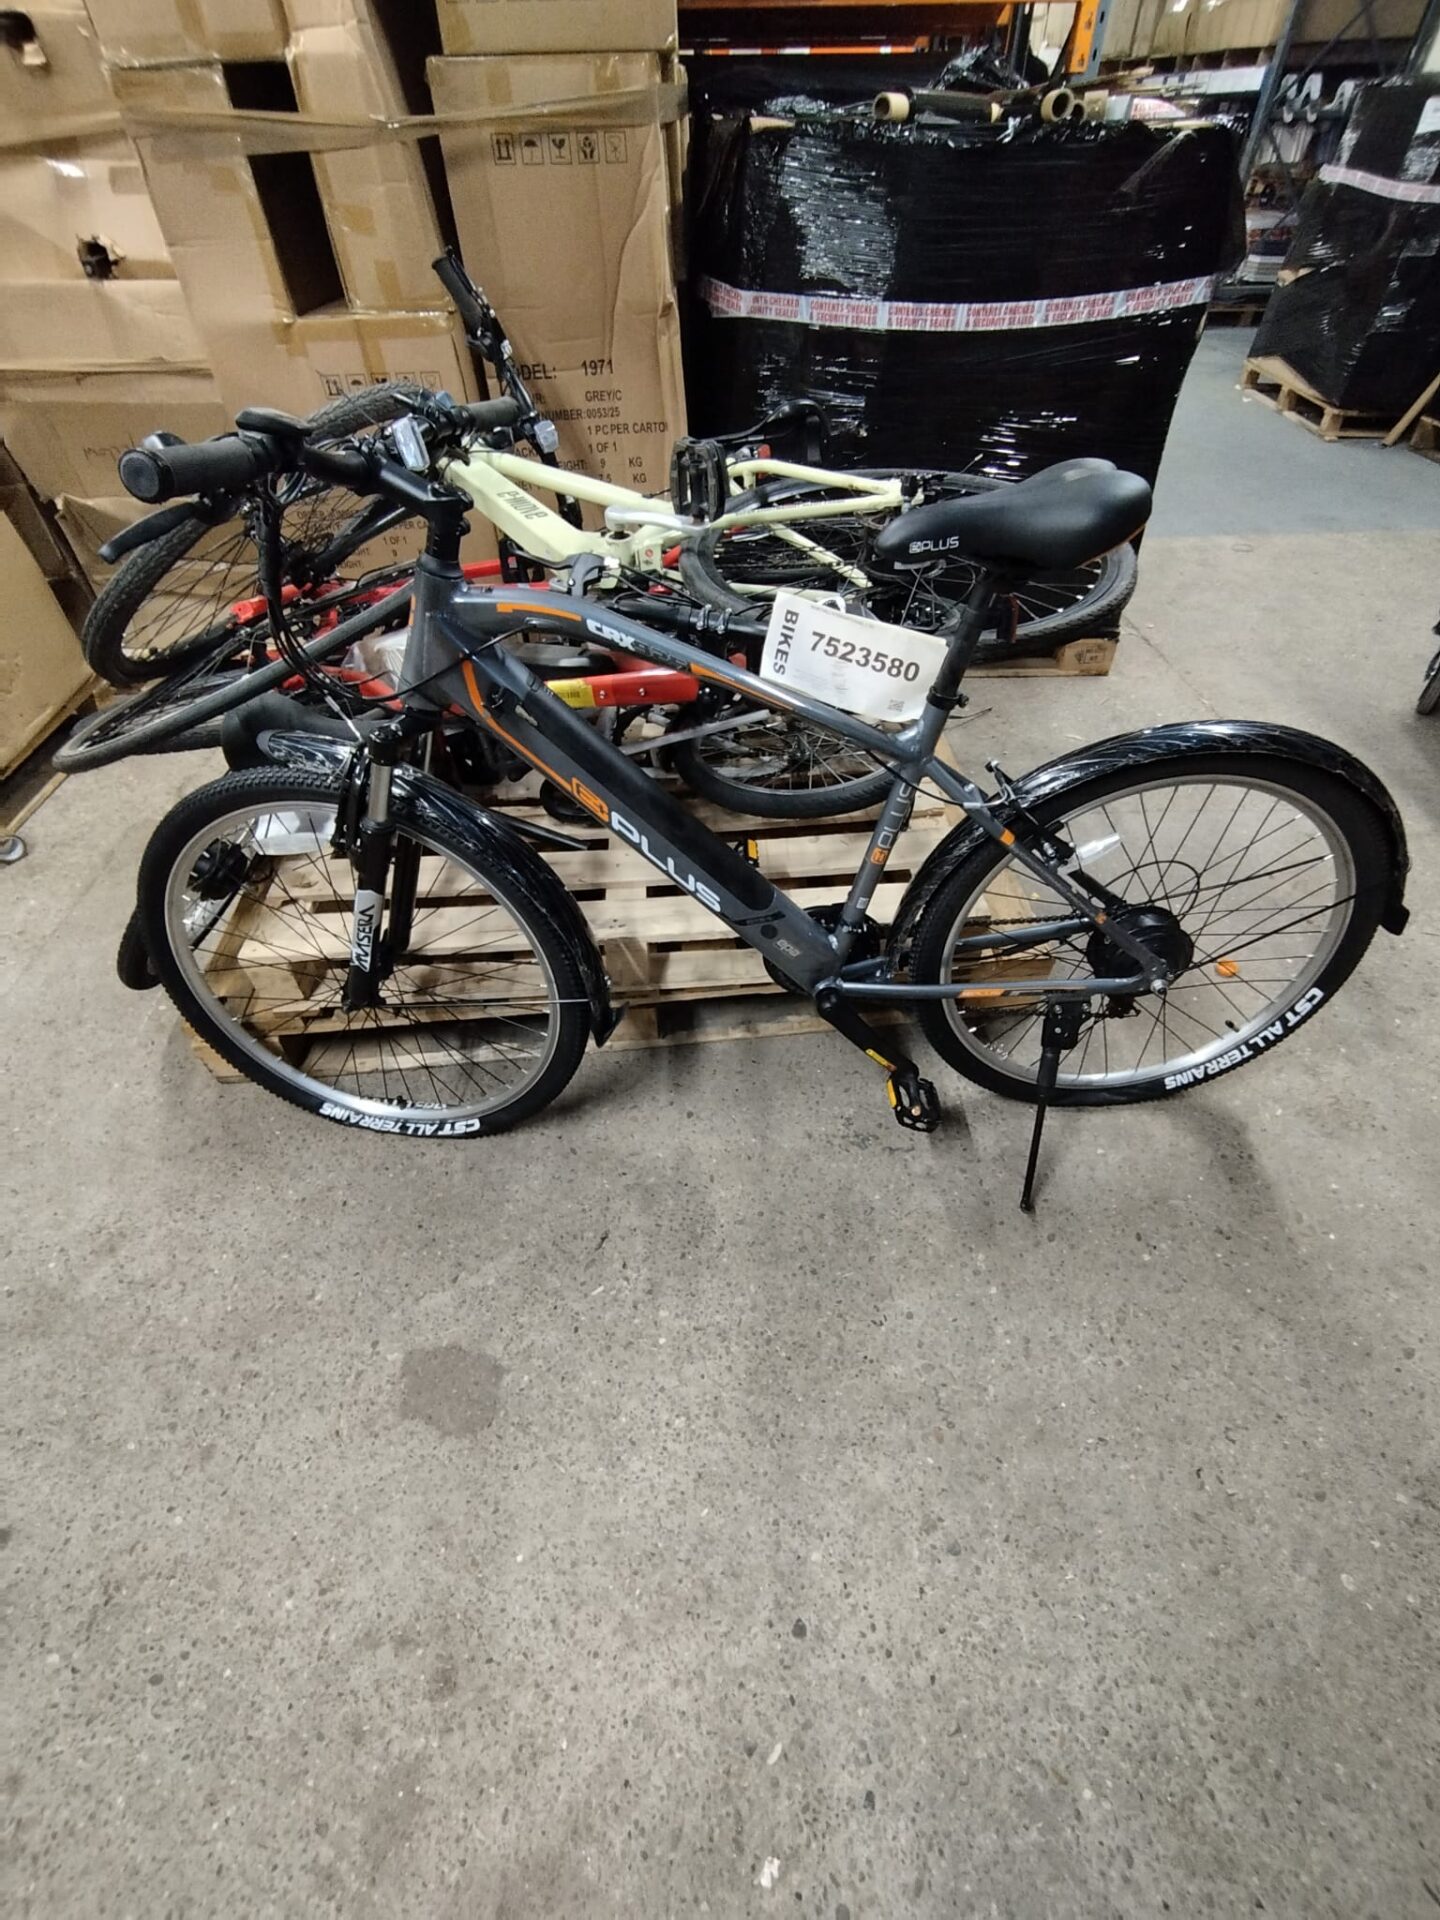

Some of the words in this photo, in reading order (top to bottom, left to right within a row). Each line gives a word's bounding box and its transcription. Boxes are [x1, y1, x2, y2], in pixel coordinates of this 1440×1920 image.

[581, 359, 614, 376] 1971
[587, 425, 592, 436] 1
[595, 424, 609, 435] PC
[610, 422, 630, 434] PER
[632, 421, 668, 434] CARTO
[588, 443, 593, 454] 1
[596, 442, 609, 453] OF
[613, 441, 618, 452] 1
[628, 456, 643, 468] KG
[632, 472, 647, 484] KG
[773, 609, 800, 676] BIKES
[810, 631, 920, 682] 7523580
[1284, 986, 1325, 1028] CST
[1249, 1020, 1285, 1048] ALL
[1163, 1045, 1254, 1090] TERRAINS
[318, 1101, 403, 1134] TERRAINS
[406, 1122, 442, 1136] ALL
[437, 1118, 481, 1136] CST
